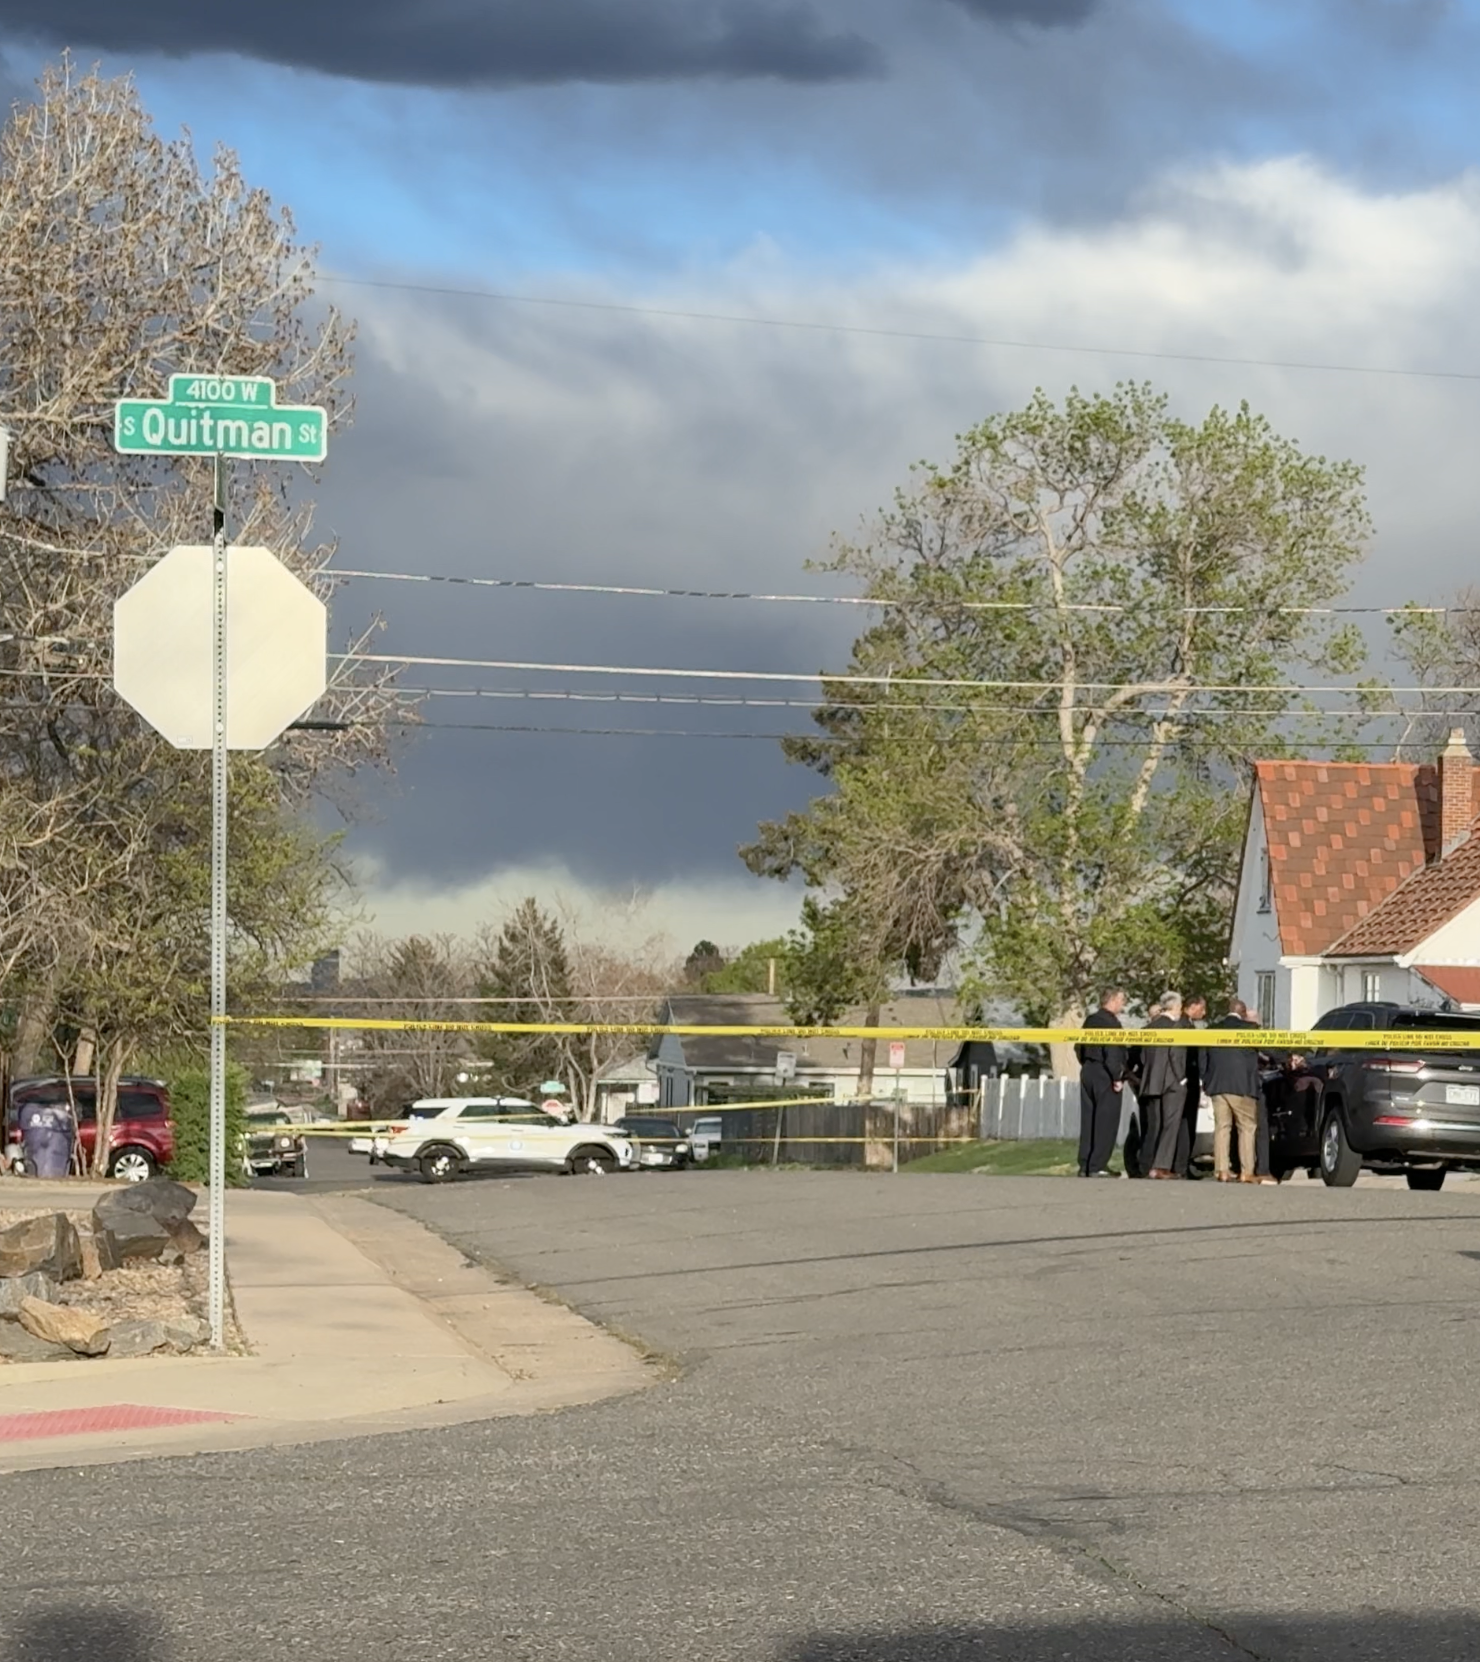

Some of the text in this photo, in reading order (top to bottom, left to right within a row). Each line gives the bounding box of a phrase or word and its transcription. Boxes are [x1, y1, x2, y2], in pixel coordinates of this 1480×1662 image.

[186, 380, 258, 402] 4100 W
[123, 408, 318, 450] S Quitman St
